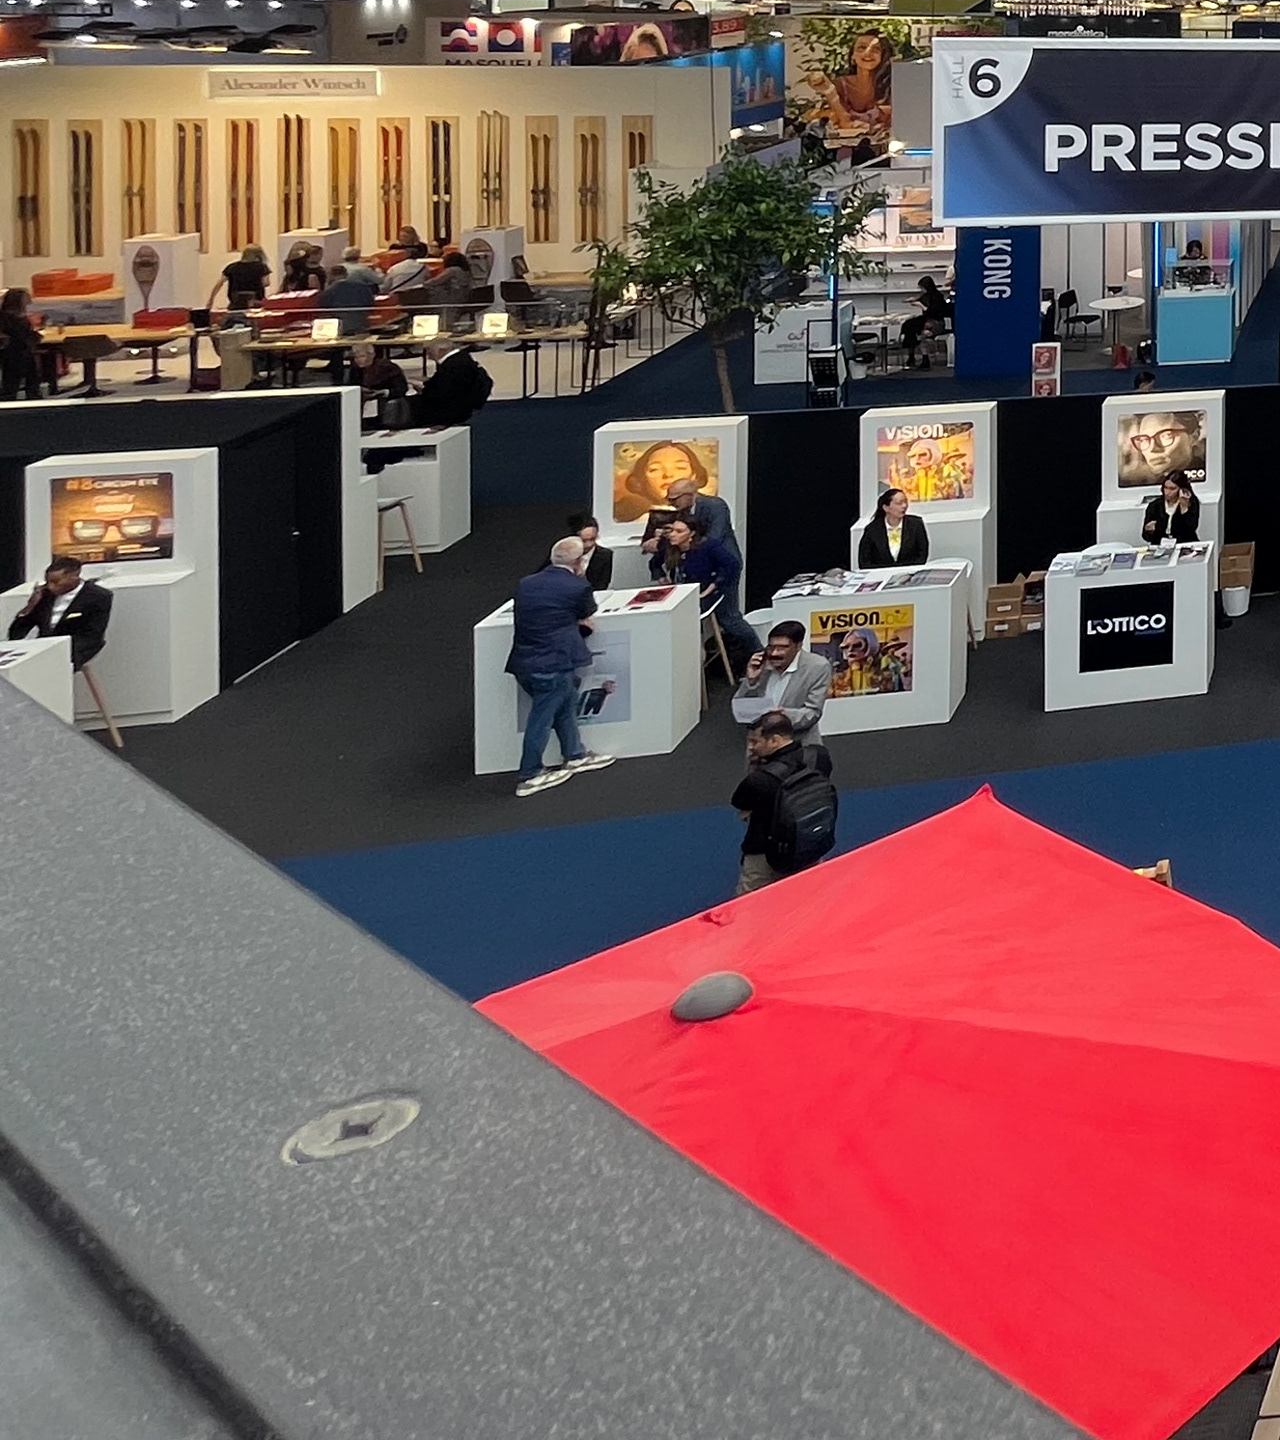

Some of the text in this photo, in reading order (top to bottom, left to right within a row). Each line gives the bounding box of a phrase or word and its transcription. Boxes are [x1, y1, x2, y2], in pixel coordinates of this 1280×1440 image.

[952, 56, 966, 100] HALL
[967, 58, 1002, 99] 6
[982, 238, 1013, 299] KONG
